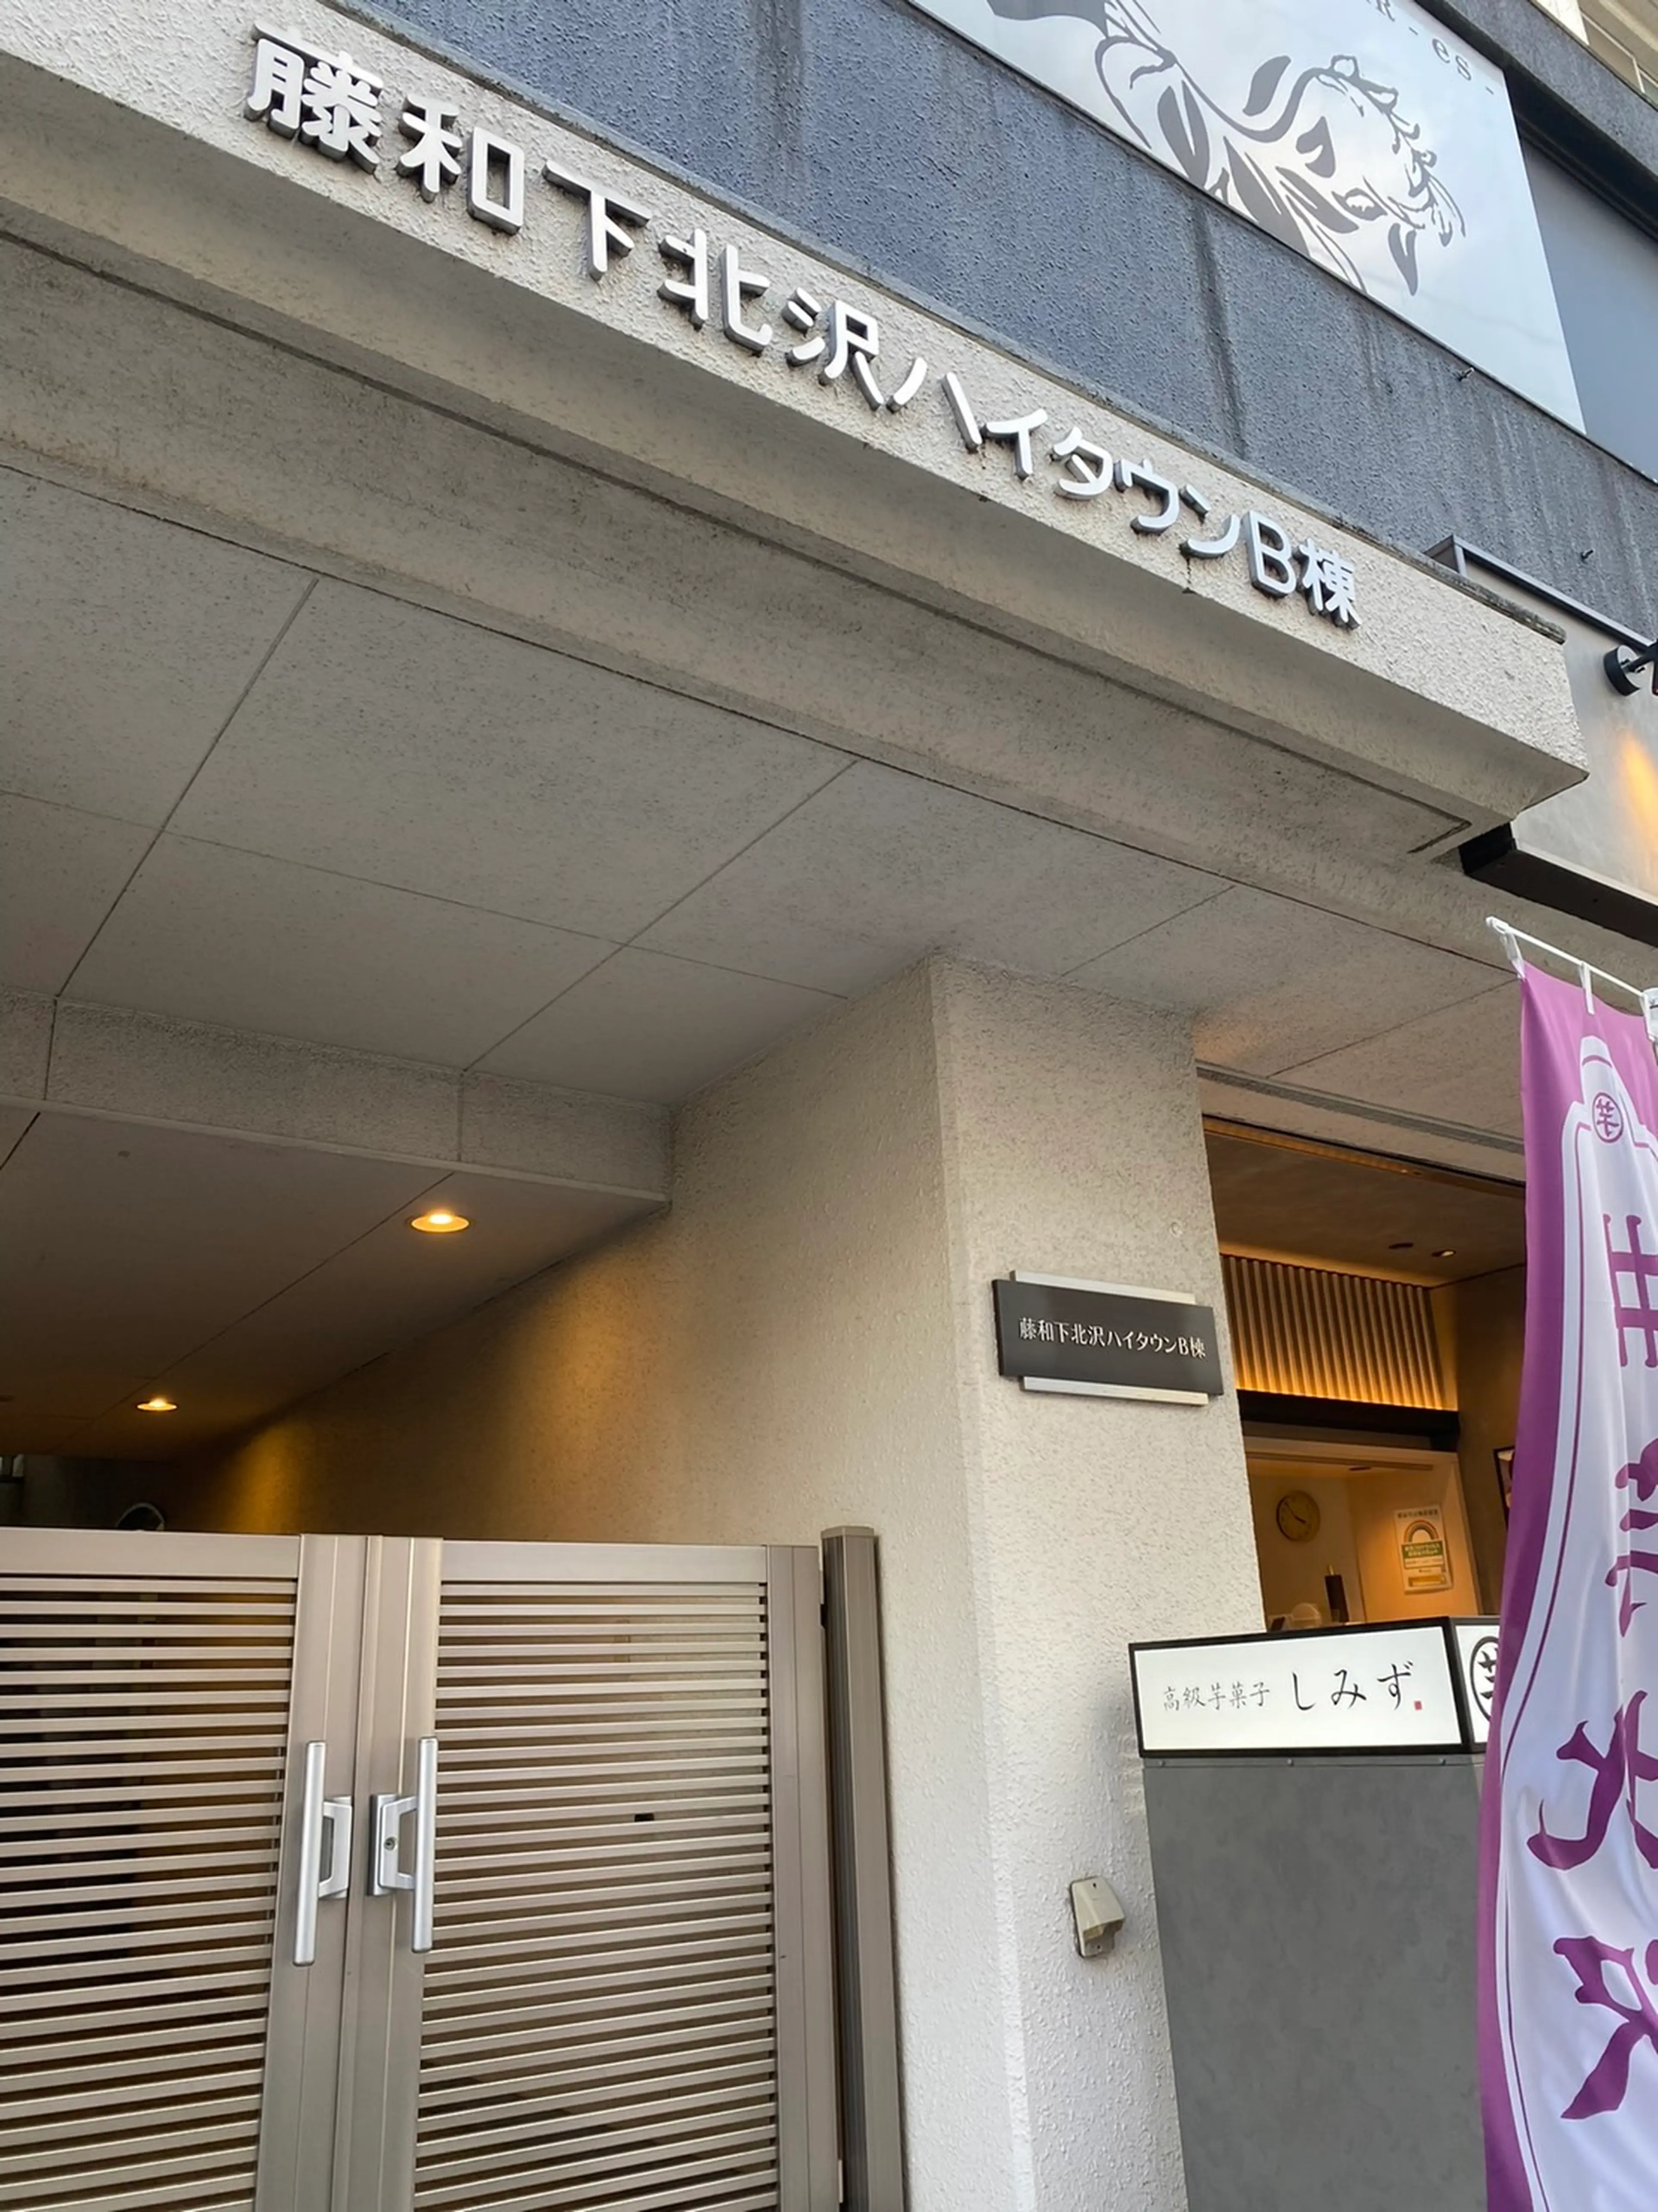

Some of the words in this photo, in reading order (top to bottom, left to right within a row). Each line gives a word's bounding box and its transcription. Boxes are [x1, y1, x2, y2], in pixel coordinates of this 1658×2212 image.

[243, 22, 1362, 631] 藤和下北沢ハイタウンB棟
[1019, 1317, 1207, 1360] 藤和下北沢ハイタウンB棟
[1162, 1681, 1270, 1712] 高級芋菓子
[1292, 1661, 1413, 1711] しみず
